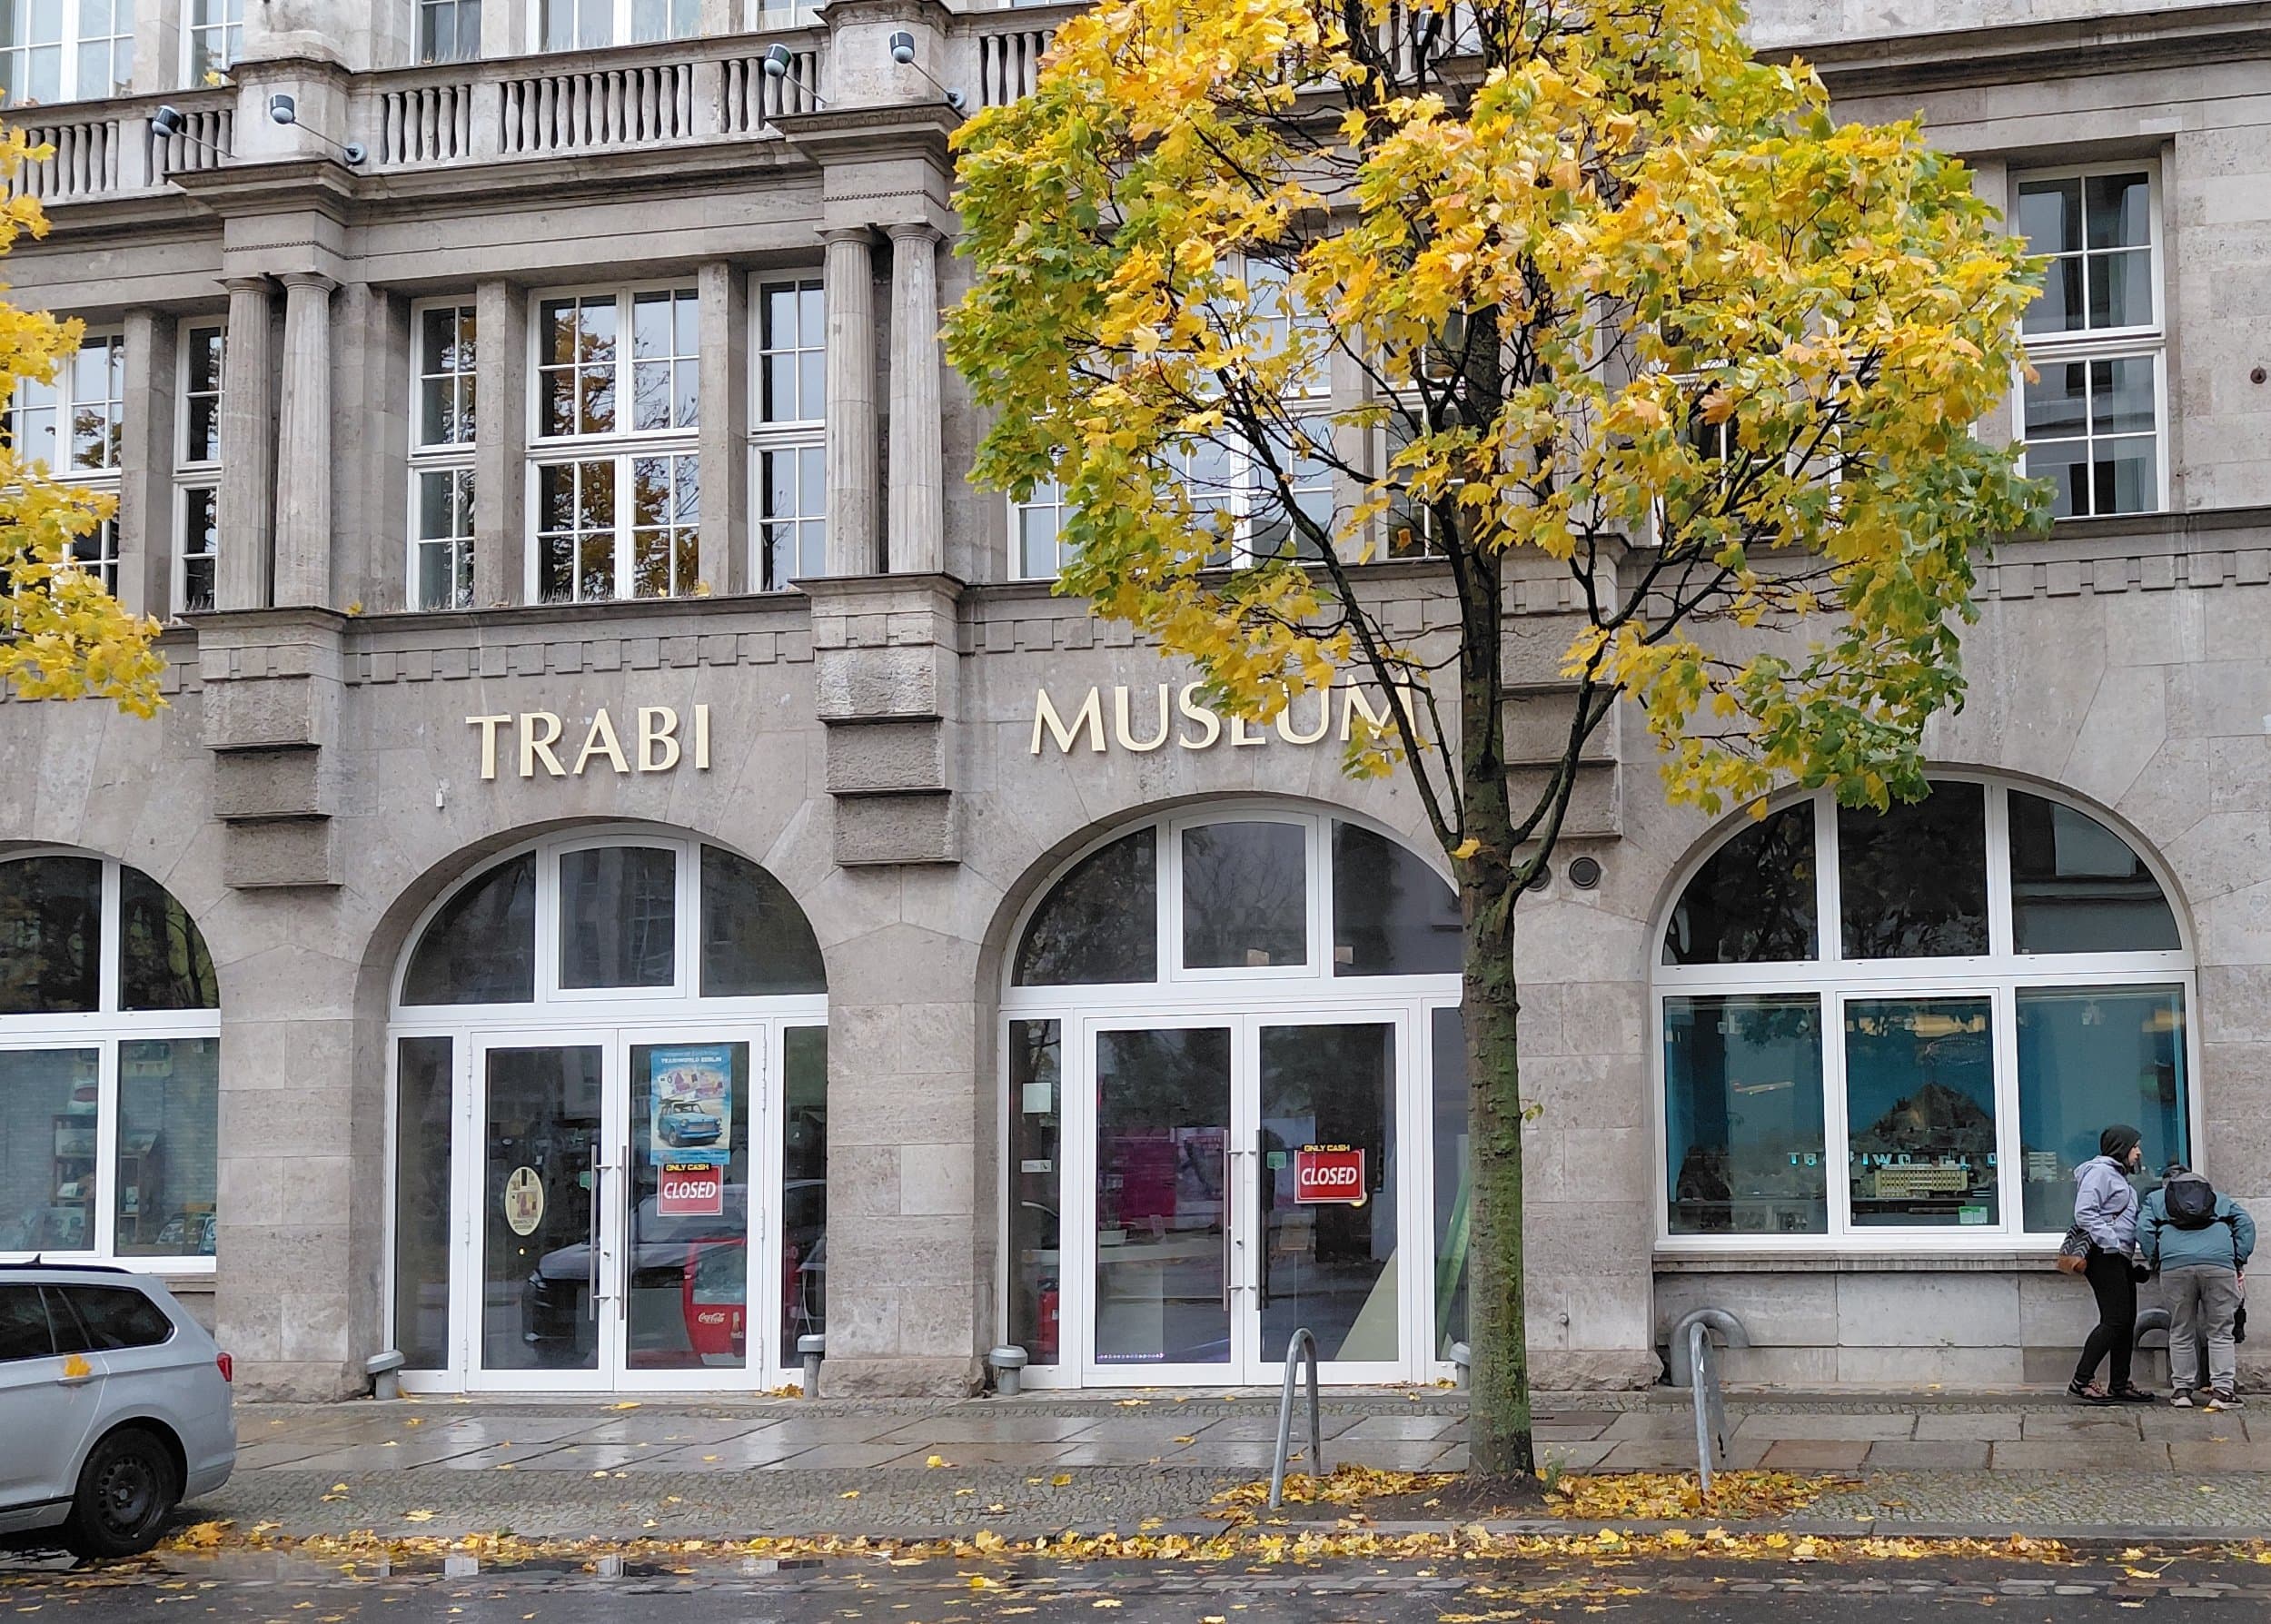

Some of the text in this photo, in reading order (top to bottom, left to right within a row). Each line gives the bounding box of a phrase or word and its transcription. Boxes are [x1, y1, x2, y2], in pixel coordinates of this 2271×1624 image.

[465, 704, 710, 779] TRABI
[1301, 1167, 1356, 1184] CLOSED
[664, 1182, 716, 1199] CLOSED
